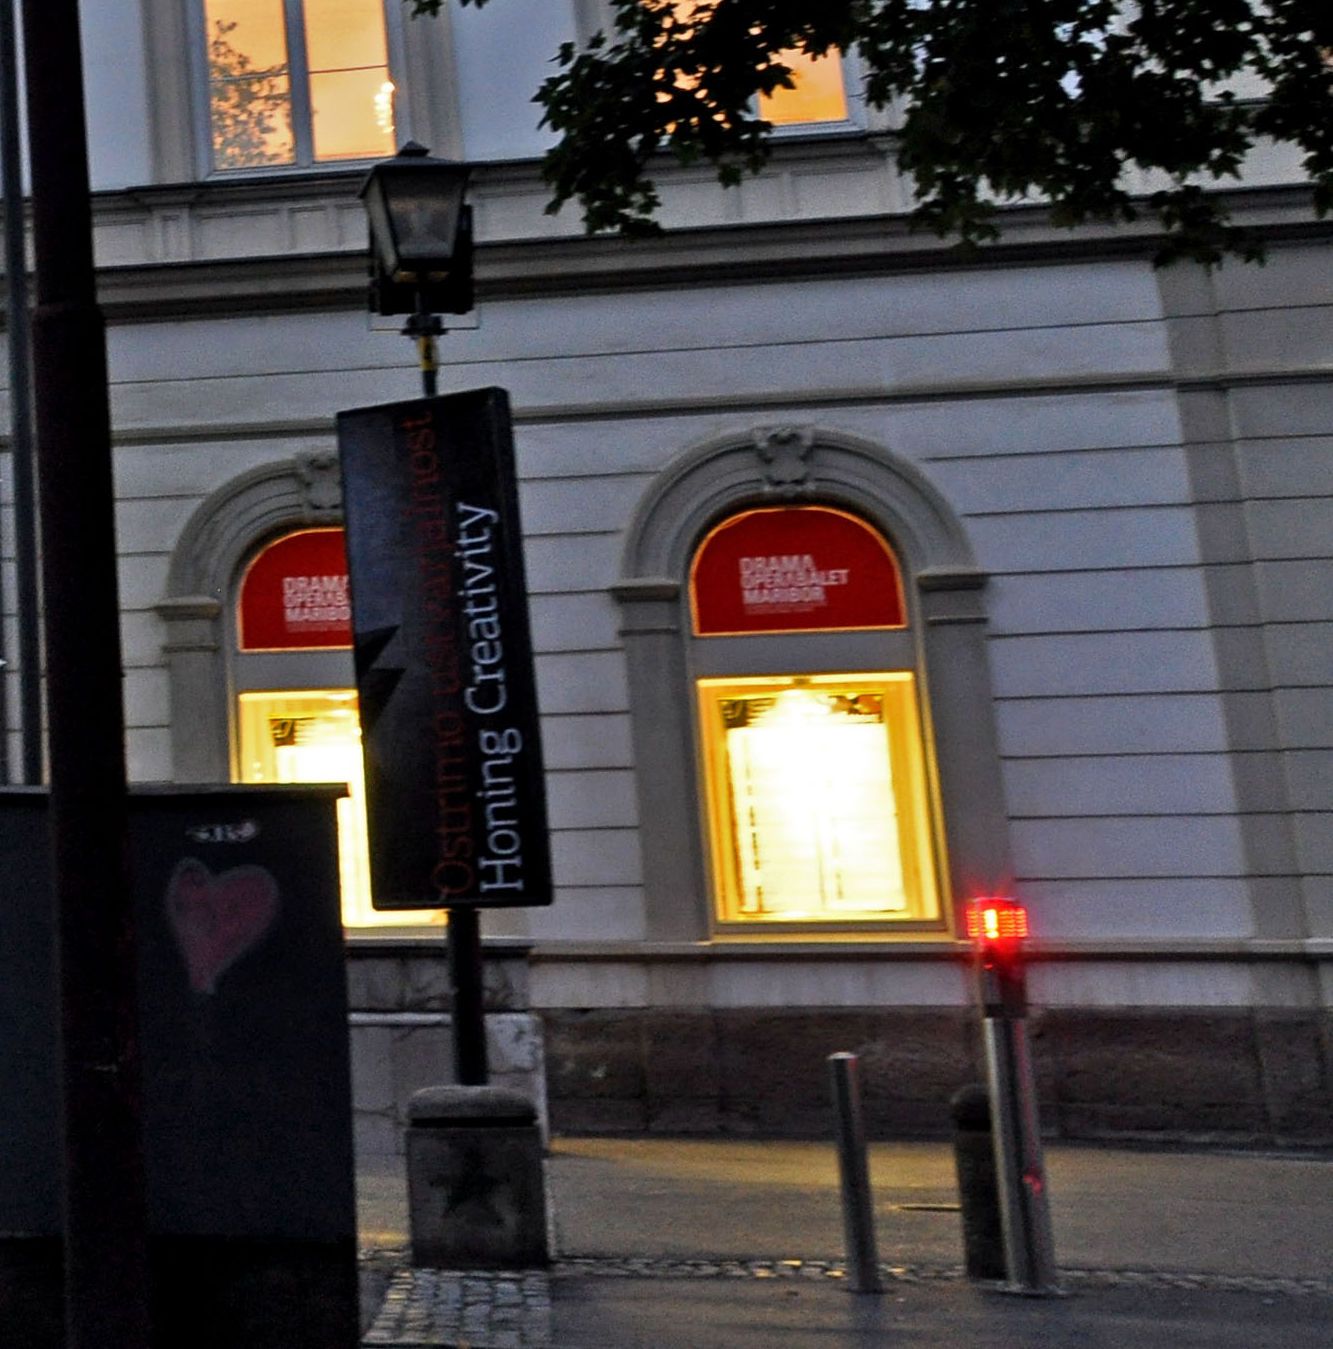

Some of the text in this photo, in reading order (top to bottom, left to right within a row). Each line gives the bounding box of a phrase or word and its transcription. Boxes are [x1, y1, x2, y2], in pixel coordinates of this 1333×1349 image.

[739, 554, 816, 573] DRAMA
[742, 586, 825, 604] MARIBOR
[285, 606, 351, 622] MARIBO
[456, 502, 524, 893] Honing Creativity
[431, 711, 475, 896] Ostrimo
